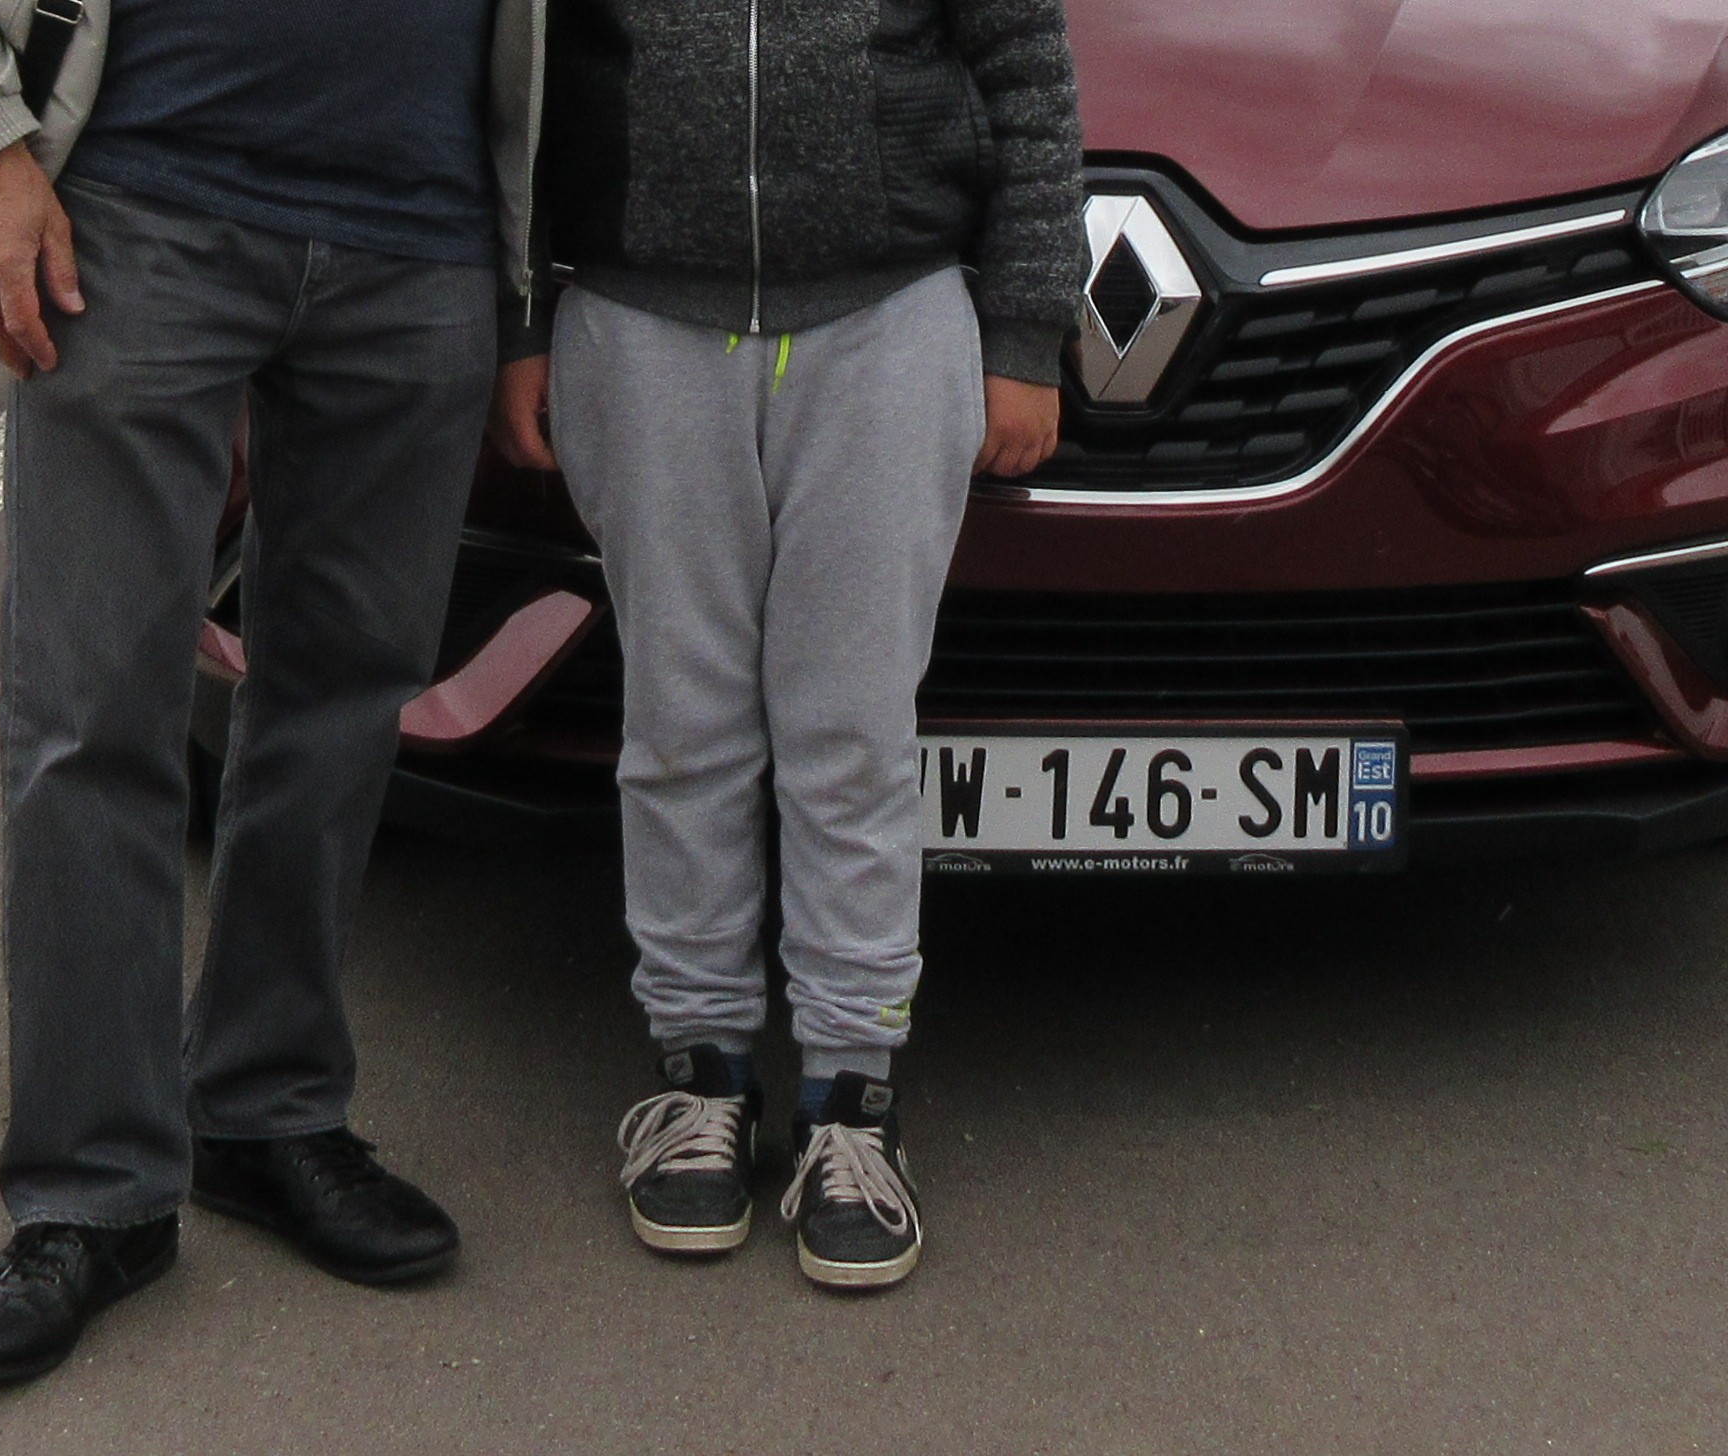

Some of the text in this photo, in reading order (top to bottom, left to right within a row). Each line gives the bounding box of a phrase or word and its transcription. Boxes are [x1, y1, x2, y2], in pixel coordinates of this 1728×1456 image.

[1358, 750, 1391, 761] Grand
[1358, 762, 1391, 780] Est
[919, 747, 1340, 839] W-146-SM
[1354, 800, 1392, 842] 10
[1031, 855, 1190, 871] www.e-motors.fr
